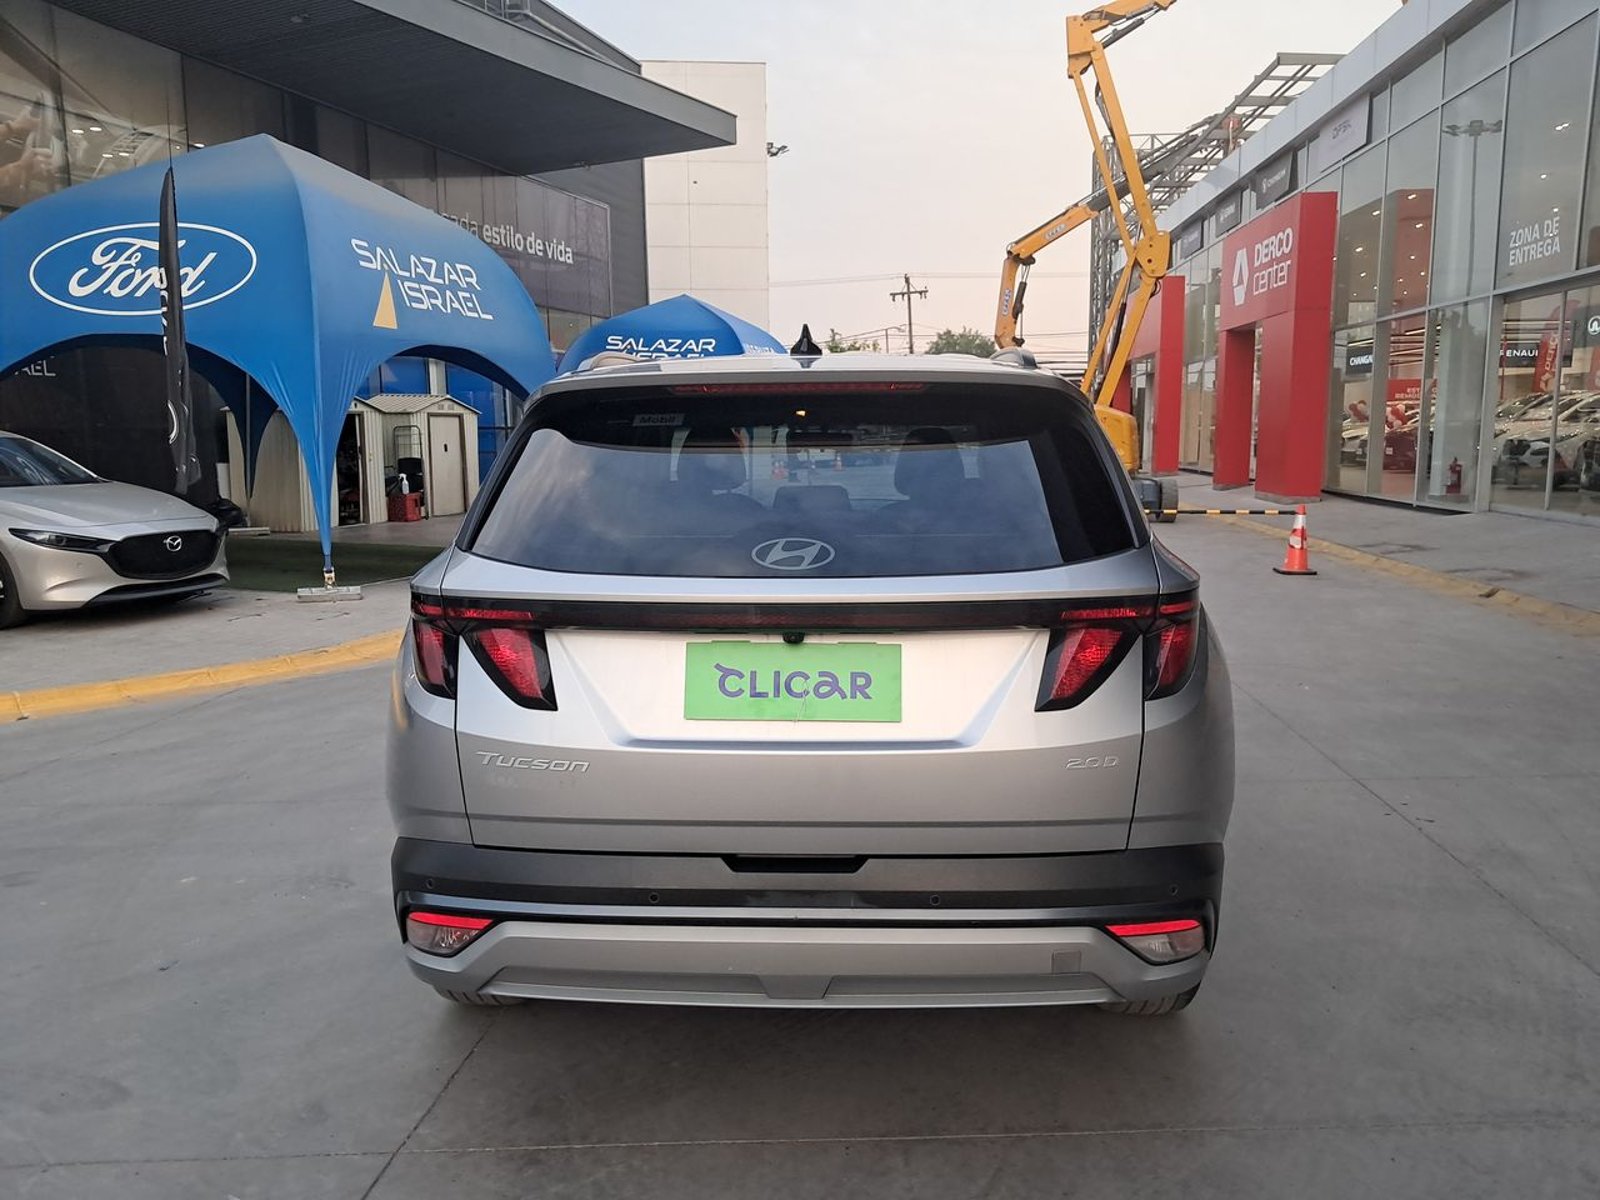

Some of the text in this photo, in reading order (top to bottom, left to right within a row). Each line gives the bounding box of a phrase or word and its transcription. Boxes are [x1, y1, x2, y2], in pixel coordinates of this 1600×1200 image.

[482, 223, 524, 252] estilo
[526, 231, 544, 256] de
[545, 239, 573, 264] vida
[1254, 227, 1293, 267] DERCO
[1509, 217, 1560, 249] ZONA DE
[1509, 236, 1561, 266] ENTREGA
[351, 239, 481, 291] SALAZAR
[1253, 260, 1292, 295] center
[397, 279, 493, 320] ISRAEL
[606, 336, 716, 352] SALAZAR
